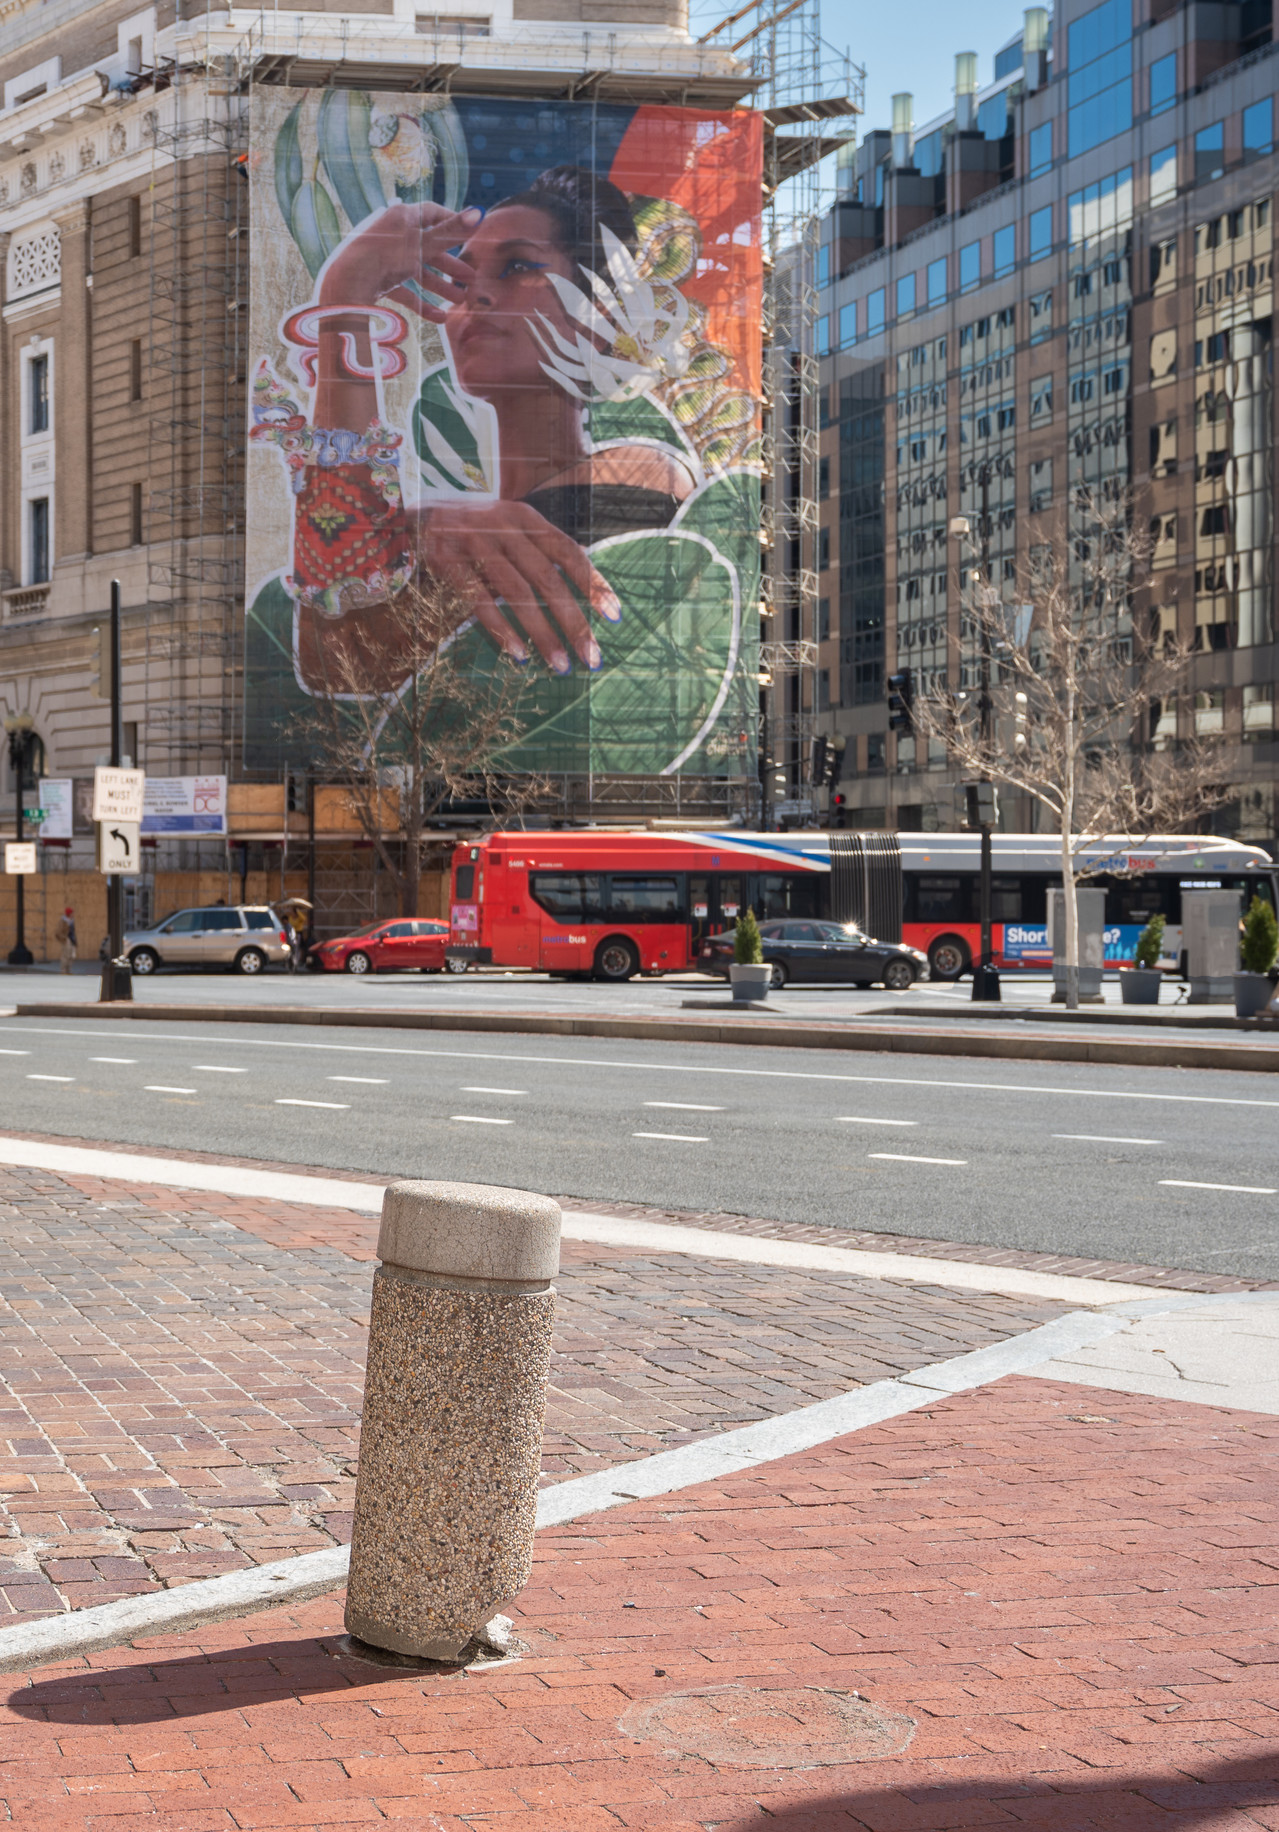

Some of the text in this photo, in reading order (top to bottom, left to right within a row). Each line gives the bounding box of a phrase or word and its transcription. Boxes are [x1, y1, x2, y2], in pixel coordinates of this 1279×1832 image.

[100, 775, 138, 784] LEFT LANE
[108, 790, 131, 800] MUST
[100, 805, 138, 814] TURN LEFT
[193, 797, 220, 813] DC
[108, 860, 132, 869] ONLY
[542, 933, 587, 944] metrobus
